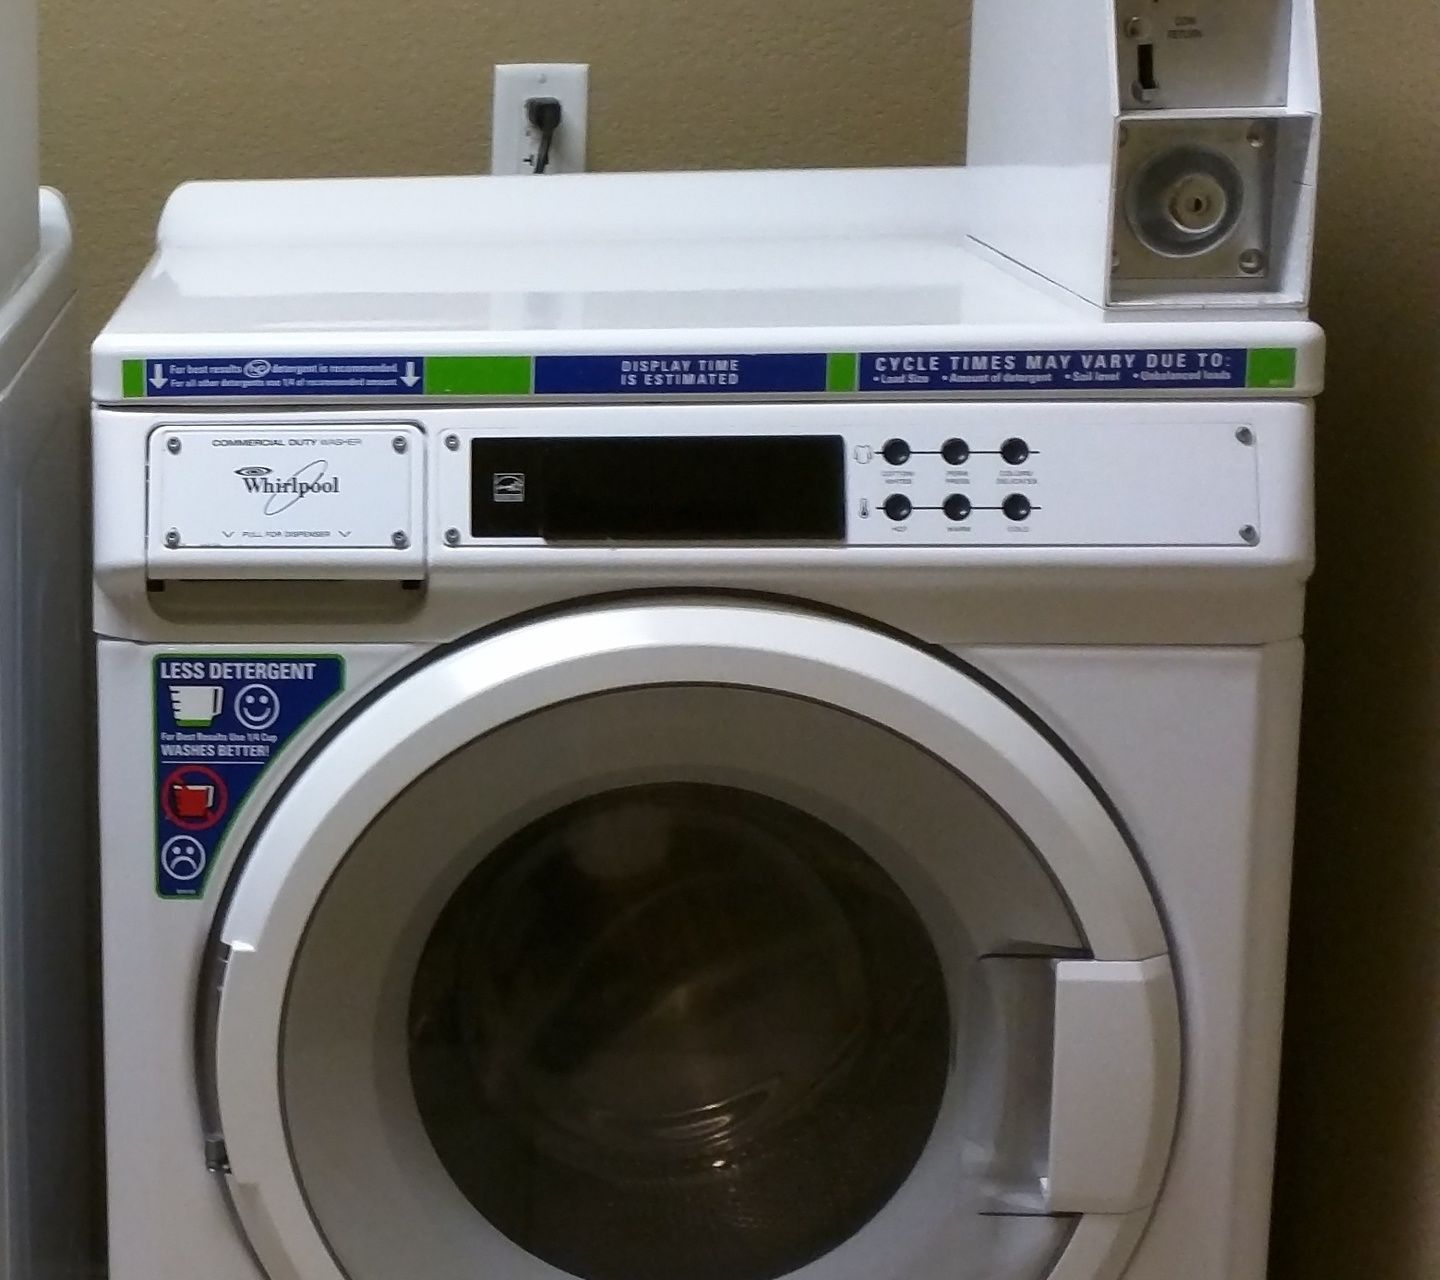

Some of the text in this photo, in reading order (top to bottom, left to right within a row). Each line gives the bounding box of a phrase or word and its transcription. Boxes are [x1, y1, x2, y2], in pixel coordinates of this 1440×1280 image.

[621, 360, 739, 372] DISPLAY TIME
[875, 353, 1231, 371] CYCLE TIMES MAY VARY DUE TO:
[169, 365, 185, 374] For
[186, 365, 208, 373] best
[209, 365, 242, 373] results
[271, 364, 317, 374] detergent
[319, 364, 328, 373] is
[329, 364, 397, 372] recommended
[621, 374, 739, 385] IS ESTIMATED
[881, 374, 929, 383] Load Size
[949, 373, 1052, 384] Amount of detergent
[1073, 372, 1120, 381] Soil level
[1141, 370, 1230, 381] Unbalanced loads
[170, 379, 184, 387] For
[242, 477, 340, 498] Whirlpool
[161, 662, 317, 680] LESS DETERGENT
[161, 732, 277, 743] For Best Results Use 1/4 Cup
[161, 745, 269, 756] WASHES BETTER!
